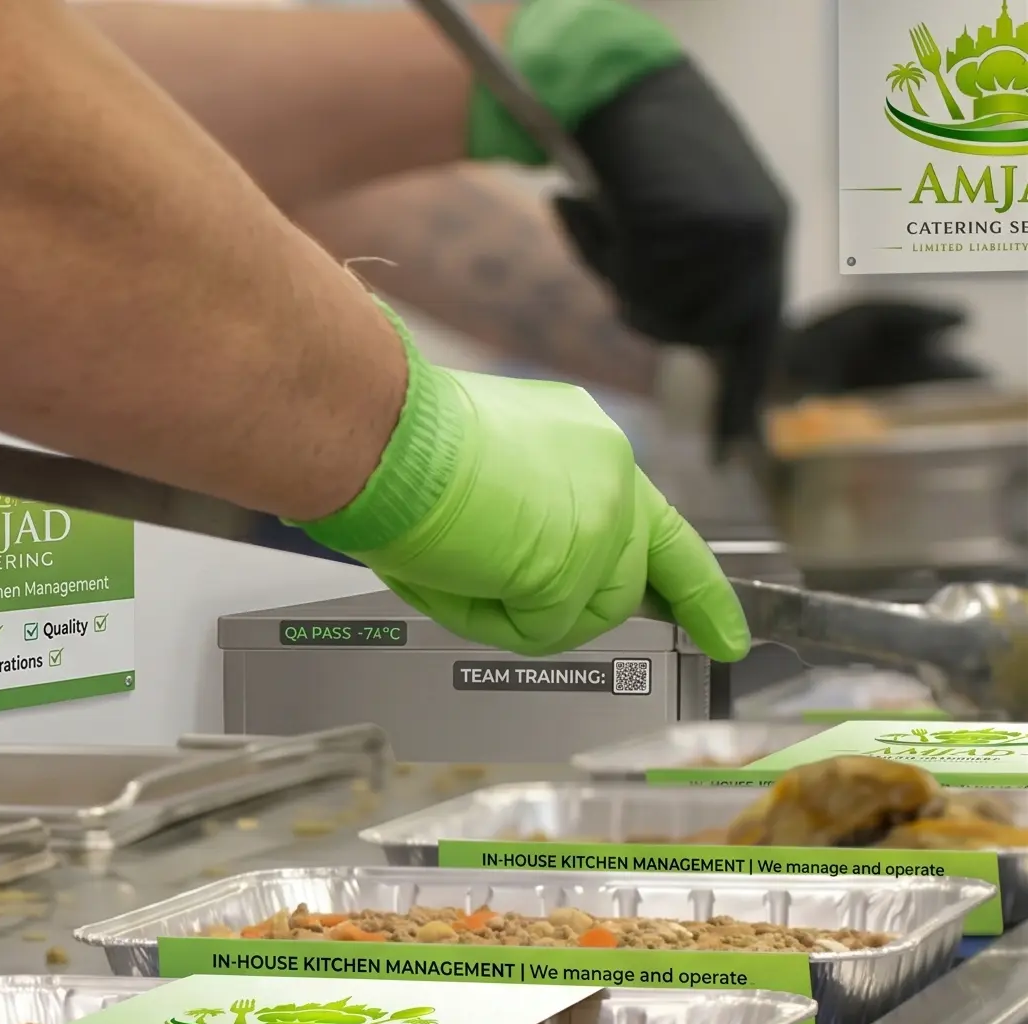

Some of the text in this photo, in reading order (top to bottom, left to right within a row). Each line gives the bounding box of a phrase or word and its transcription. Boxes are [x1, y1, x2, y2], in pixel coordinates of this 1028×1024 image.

[909, 162, 1028, 213] AMJ
[906, 221, 1002, 235] CATERING
[912, 242, 963, 252] LIMITED
[24, 575, 110, 599] Management
[43, 618, 89, 640] Quality
[285, 626, 308, 641] QA
[312, 626, 352, 640] PASS
[460, 668, 606, 685] TEAM TRAINING:
[482, 853, 557, 868] IN-HOUSE
[561, 855, 628, 870] KITCHEN
[633, 857, 745, 872] MANAGEMENT
[758, 860, 782, 873] We
[787, 862, 848, 877] manage
[852, 861, 881, 875] and
[885, 863, 945, 878] operate
[212, 953, 298, 971] IN-HOUSE
[303, 956, 381, 973] KITCHEN
[386, 959, 515, 978] MANAGEMENT
[530, 964, 558, 980] We
[563, 968, 635, 985] manage
[639, 967, 673, 983] and
[678, 970, 748, 987] operate
